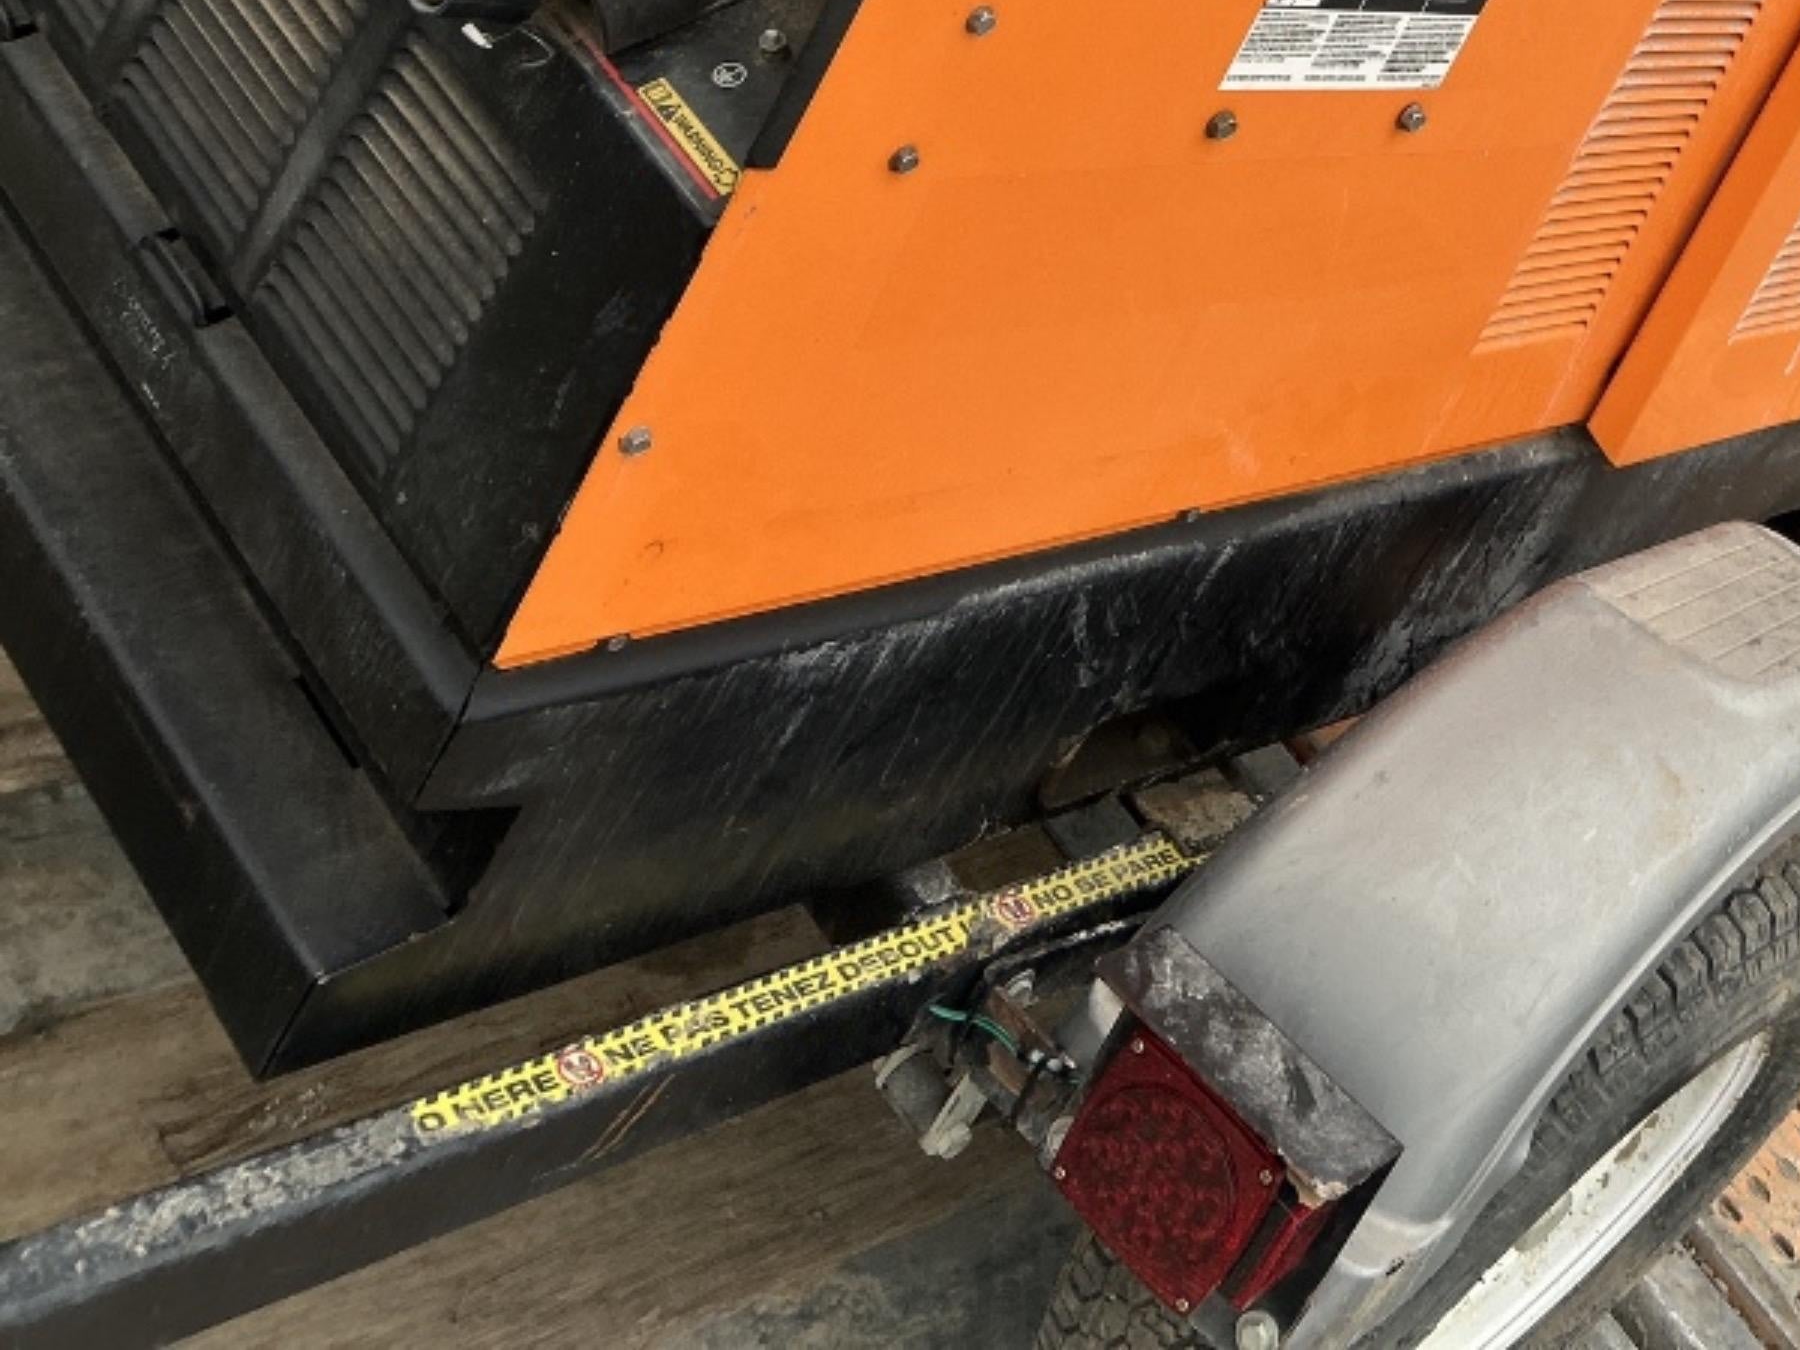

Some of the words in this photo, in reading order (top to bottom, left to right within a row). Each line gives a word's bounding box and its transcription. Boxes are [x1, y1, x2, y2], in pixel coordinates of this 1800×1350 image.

[1030, 884, 1075, 910] NO
[1110, 848, 1181, 881] PARE
[454, 1068, 555, 1117] HERE
[602, 1032, 656, 1066] NE
[659, 1009, 731, 1047] PAS
[729, 970, 831, 1016] TENEZ
[836, 924, 960, 983] DEBOUT
